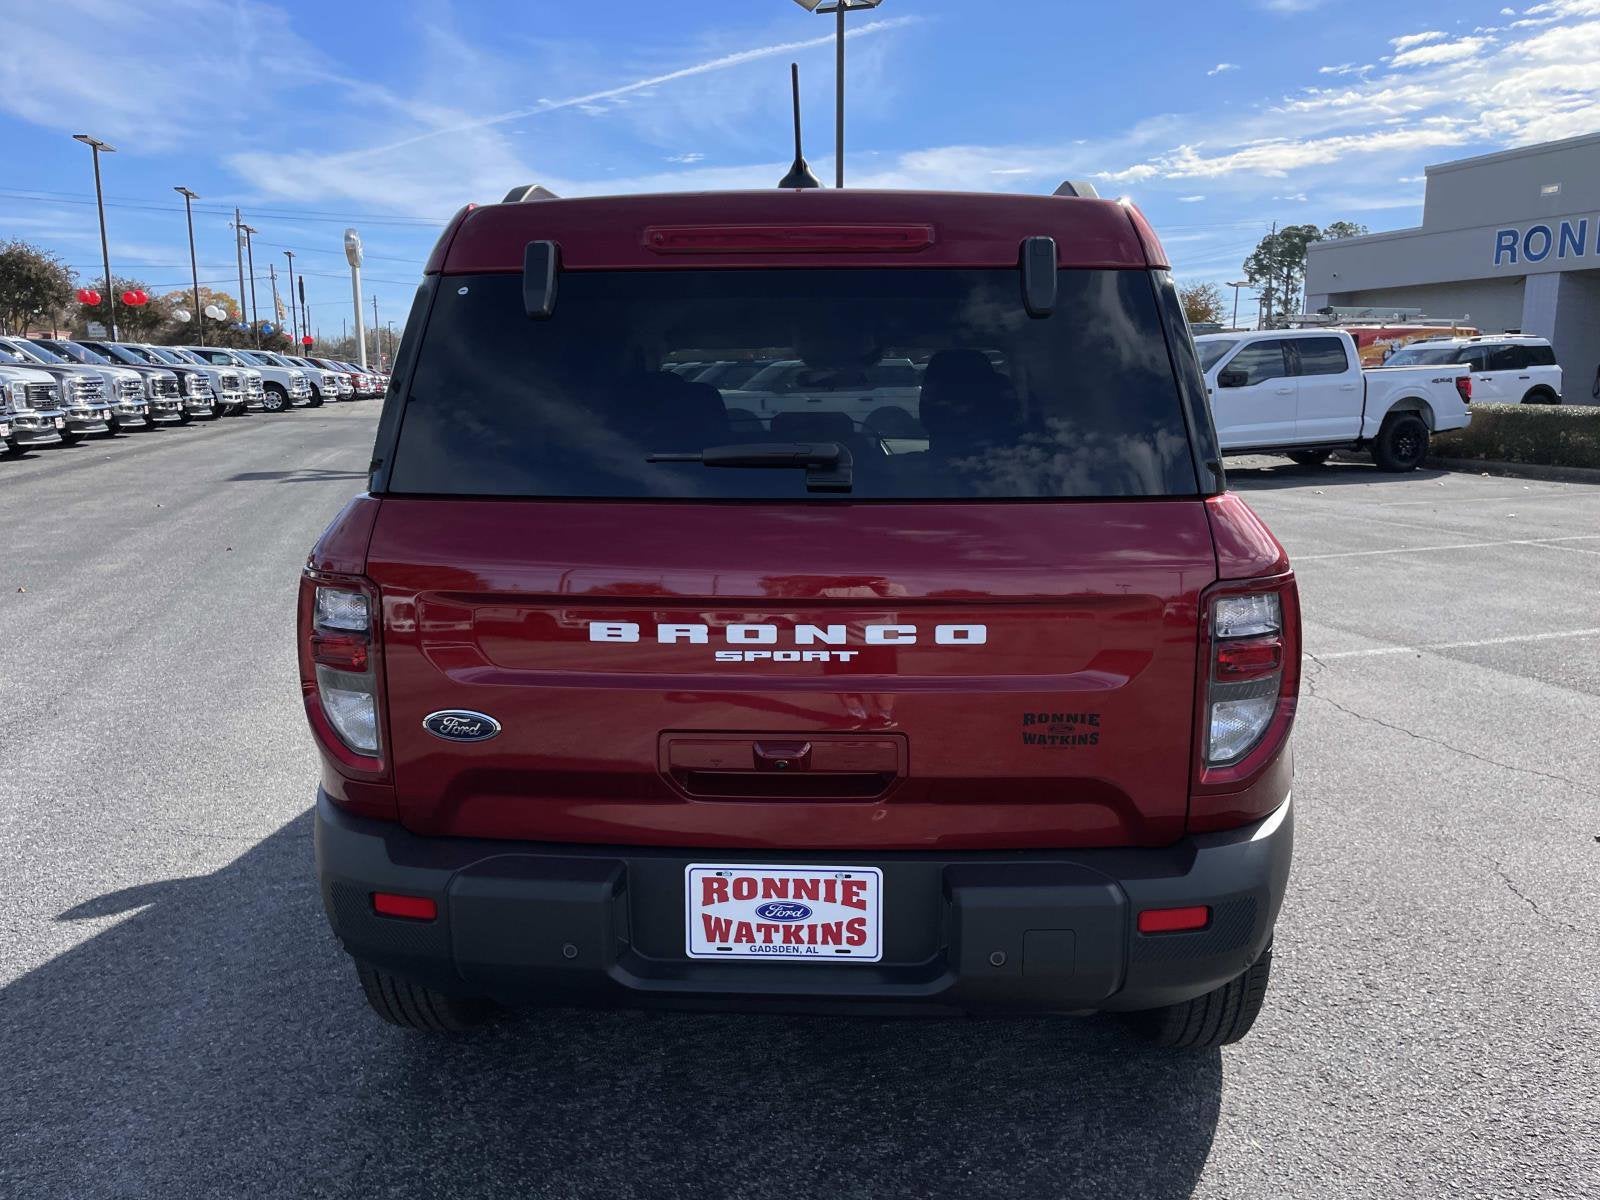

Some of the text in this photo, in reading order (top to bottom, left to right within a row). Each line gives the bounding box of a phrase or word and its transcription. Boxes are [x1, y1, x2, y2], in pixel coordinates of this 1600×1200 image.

[1493, 216, 1600, 266] RON
[589, 622, 987, 645] BRONCO
[715, 651, 859, 662] SPORT
[440, 716, 481, 736] Ford
[1023, 713, 1100, 727] RONNIE
[1022, 732, 1099, 746] WATKINS
[702, 877, 867, 911] RONNIE
[764, 903, 804, 918] Ford
[702, 913, 867, 946] WATKINS
[749, 945, 819, 954] GADSDEN, AL
